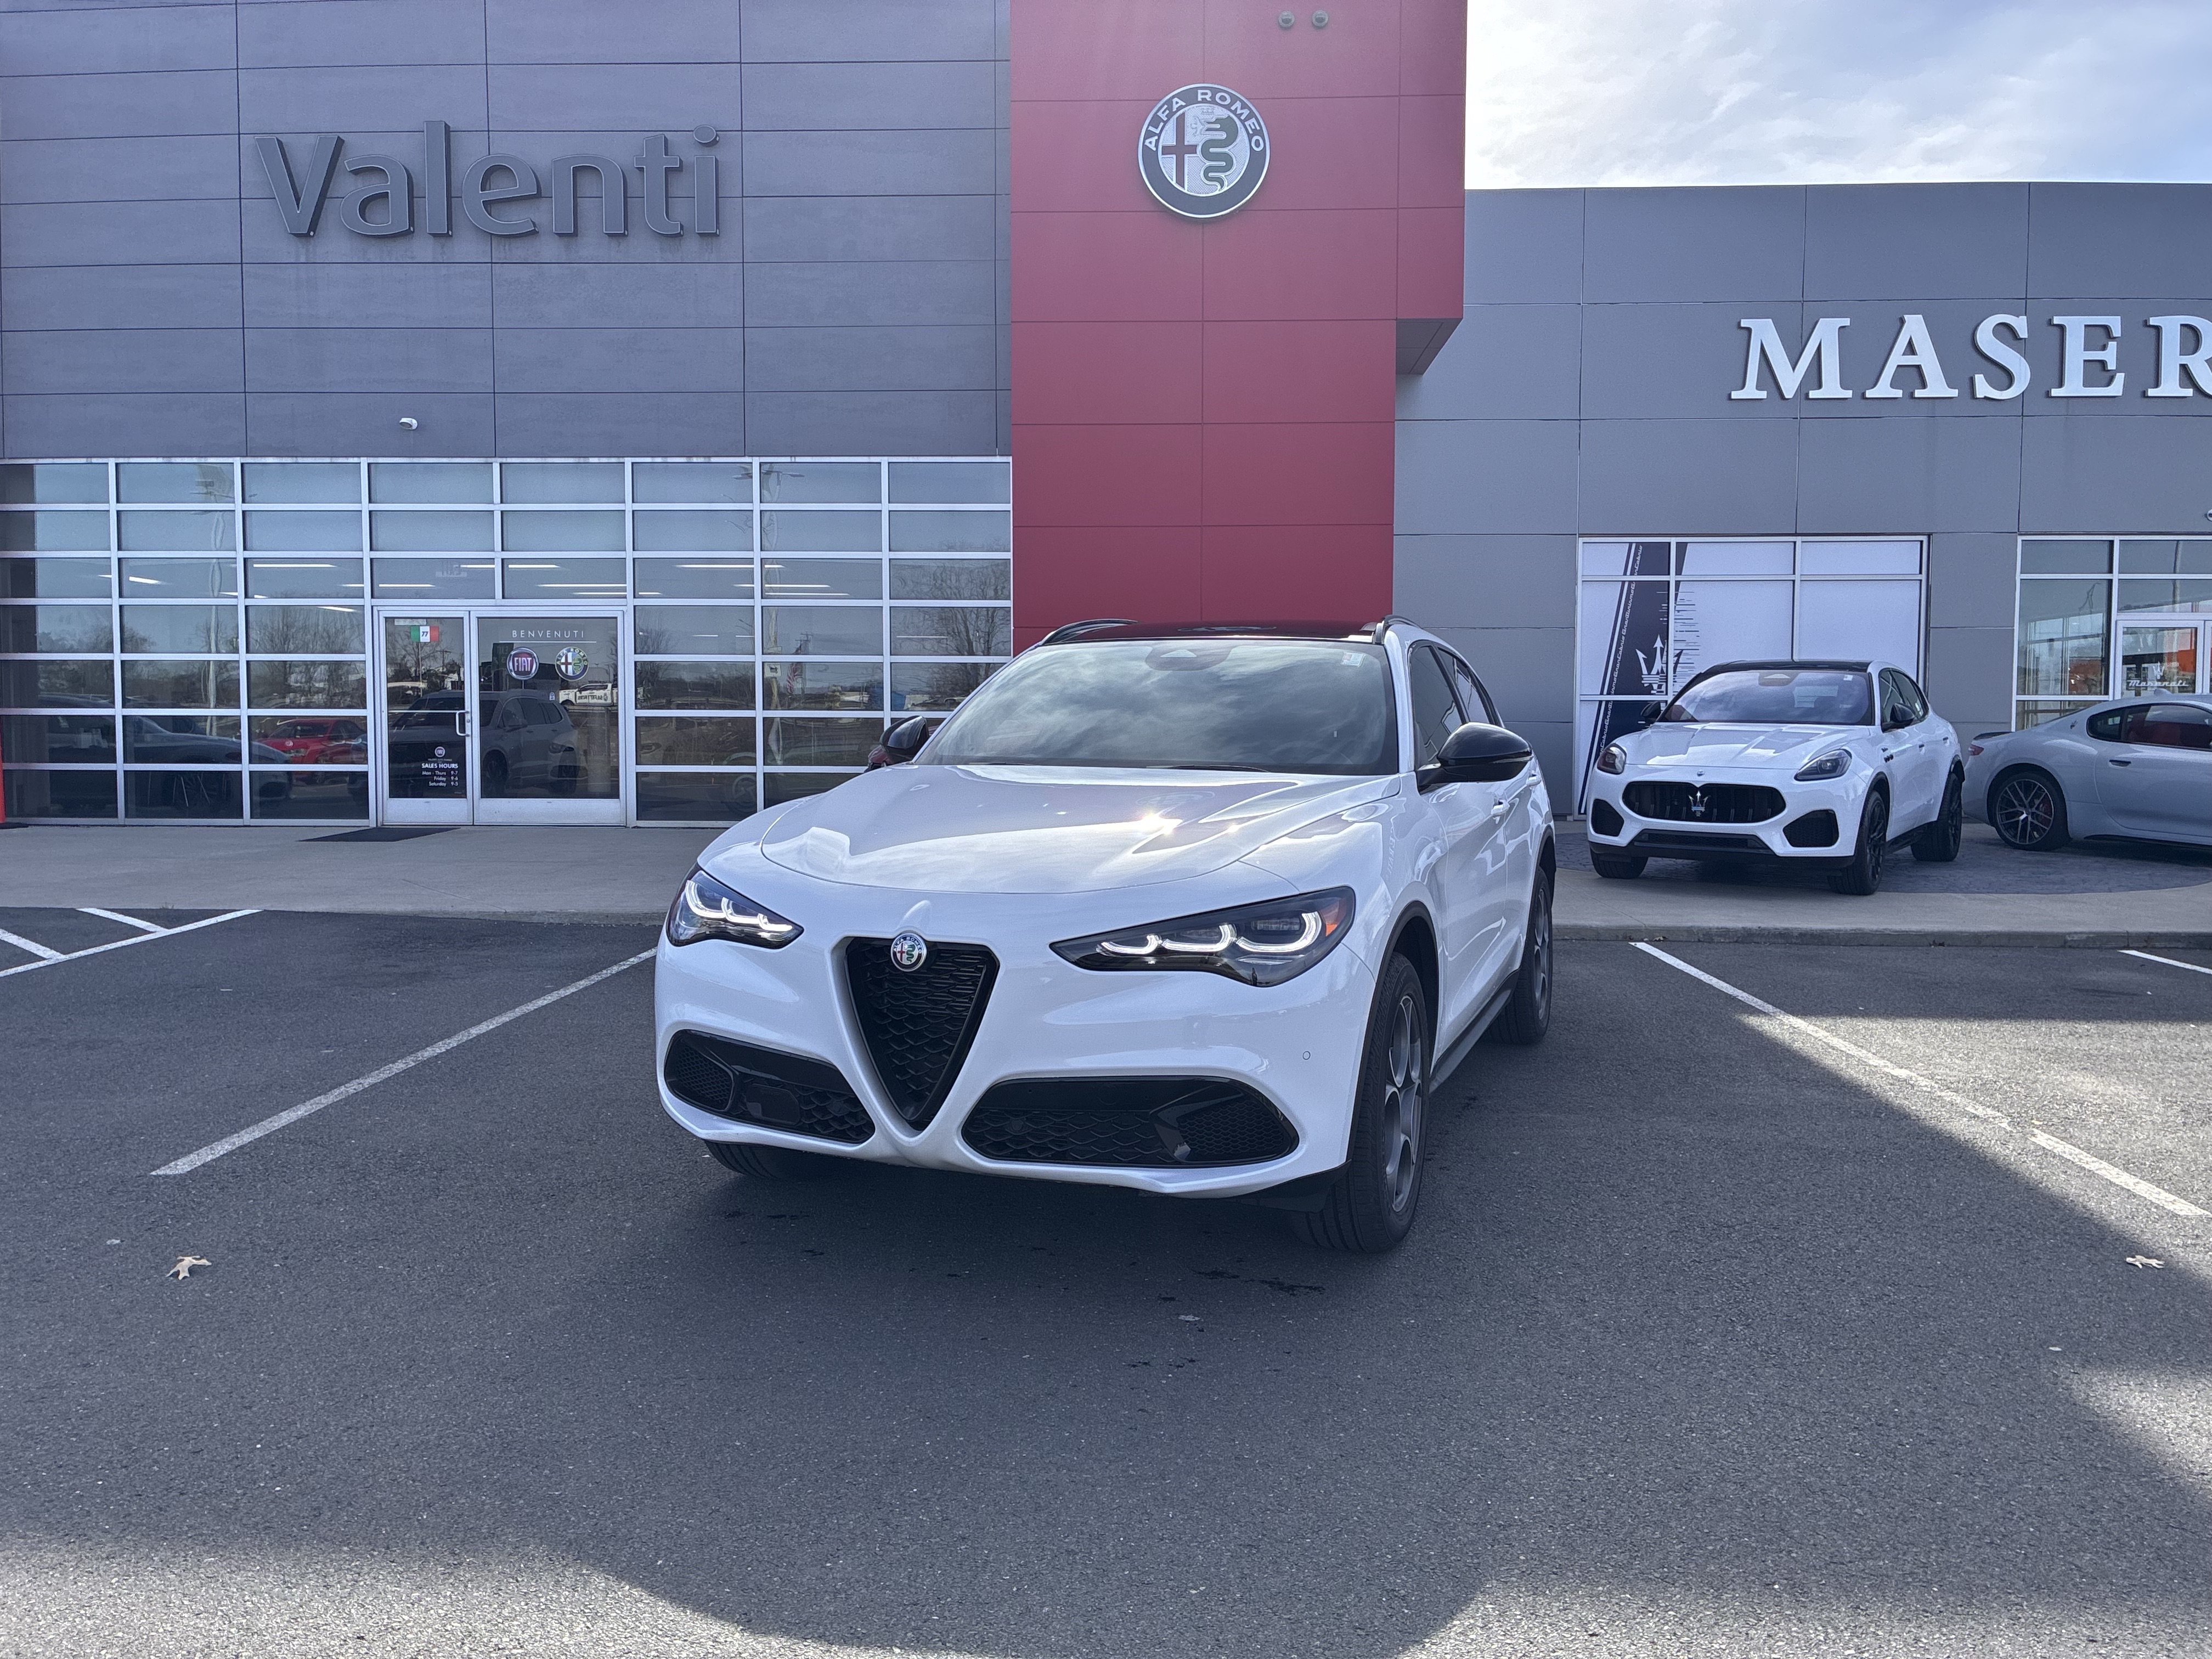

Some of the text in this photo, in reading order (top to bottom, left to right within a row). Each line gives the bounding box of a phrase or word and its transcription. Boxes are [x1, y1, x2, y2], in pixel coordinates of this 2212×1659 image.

[1144, 89, 1264, 151] ALFA ROMEO
[254, 121, 719, 236] Valenti
[1730, 313, 2212, 400] MASER
[512, 630, 584, 638] BENVENUTI
[514, 657, 532, 672] FIAT
[570, 648, 588, 665] ROMEO
[906, 936, 922, 954] ROMEO
